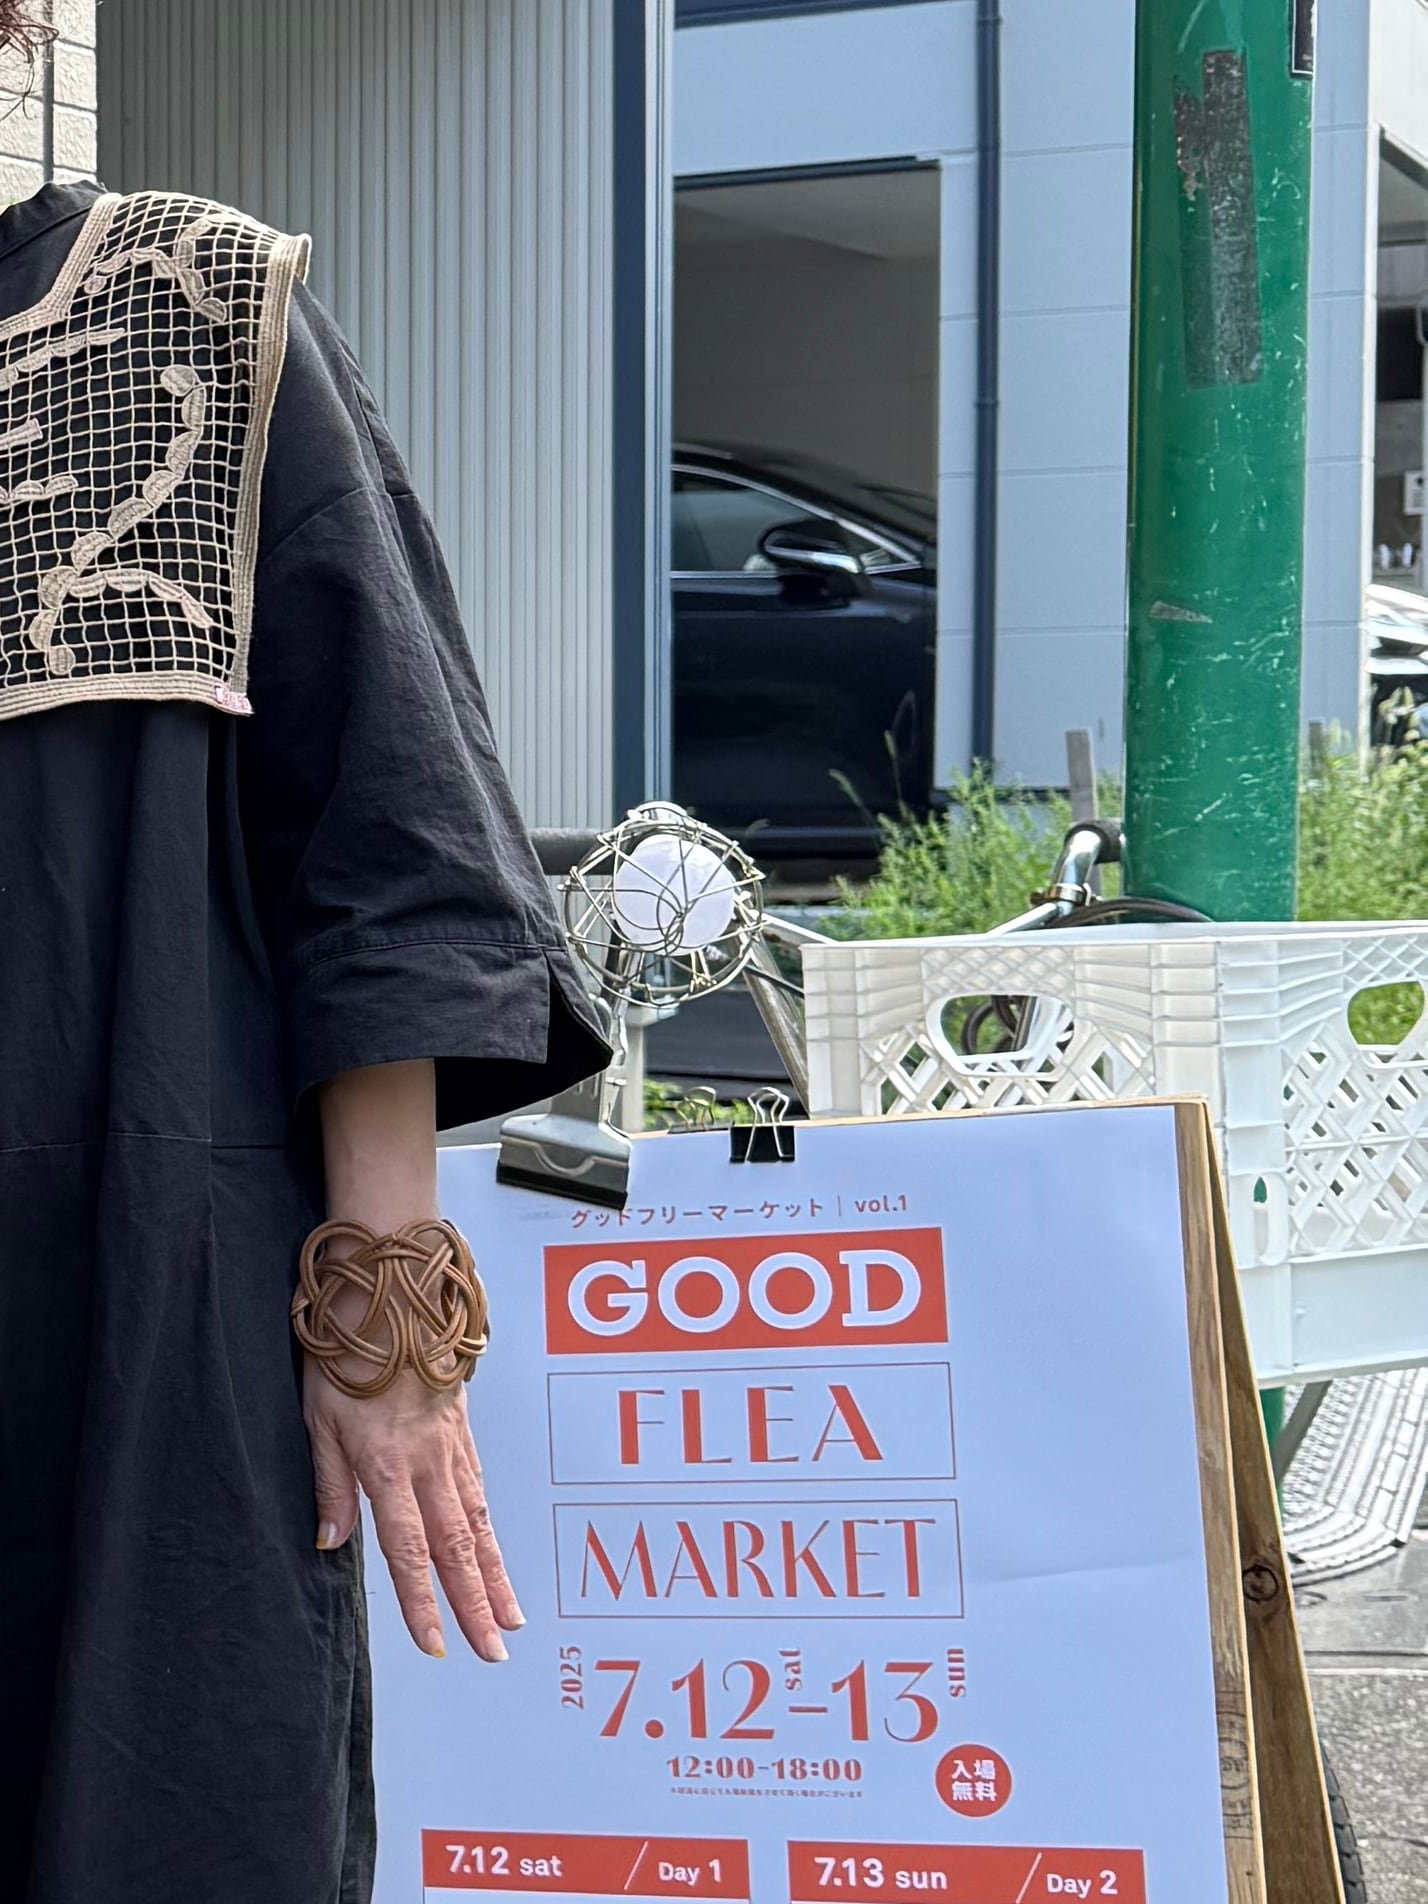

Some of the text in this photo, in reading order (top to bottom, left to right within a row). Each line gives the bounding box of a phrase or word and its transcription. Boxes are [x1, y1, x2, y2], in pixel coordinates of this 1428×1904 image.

[571, 1195, 907, 1228] グッドフリーマーケット vol.1
[567, 1249, 922, 1337] GOOD
[618, 1385, 884, 1465] FLEA
[580, 1519, 936, 1600] MARKET
[559, 1645, 584, 1710] 2025
[778, 1648, 802, 1690] sat
[946, 1648, 968, 1698] sun
[666, 1755, 863, 1782] 12:00-18:00
[951, 1758, 997, 1779] 入場
[952, 1780, 998, 1802] 無料
[445, 1844, 722, 1886] 7.12 sat Day 1
[814, 1856, 1118, 1898] 7.13 sun Day 2
